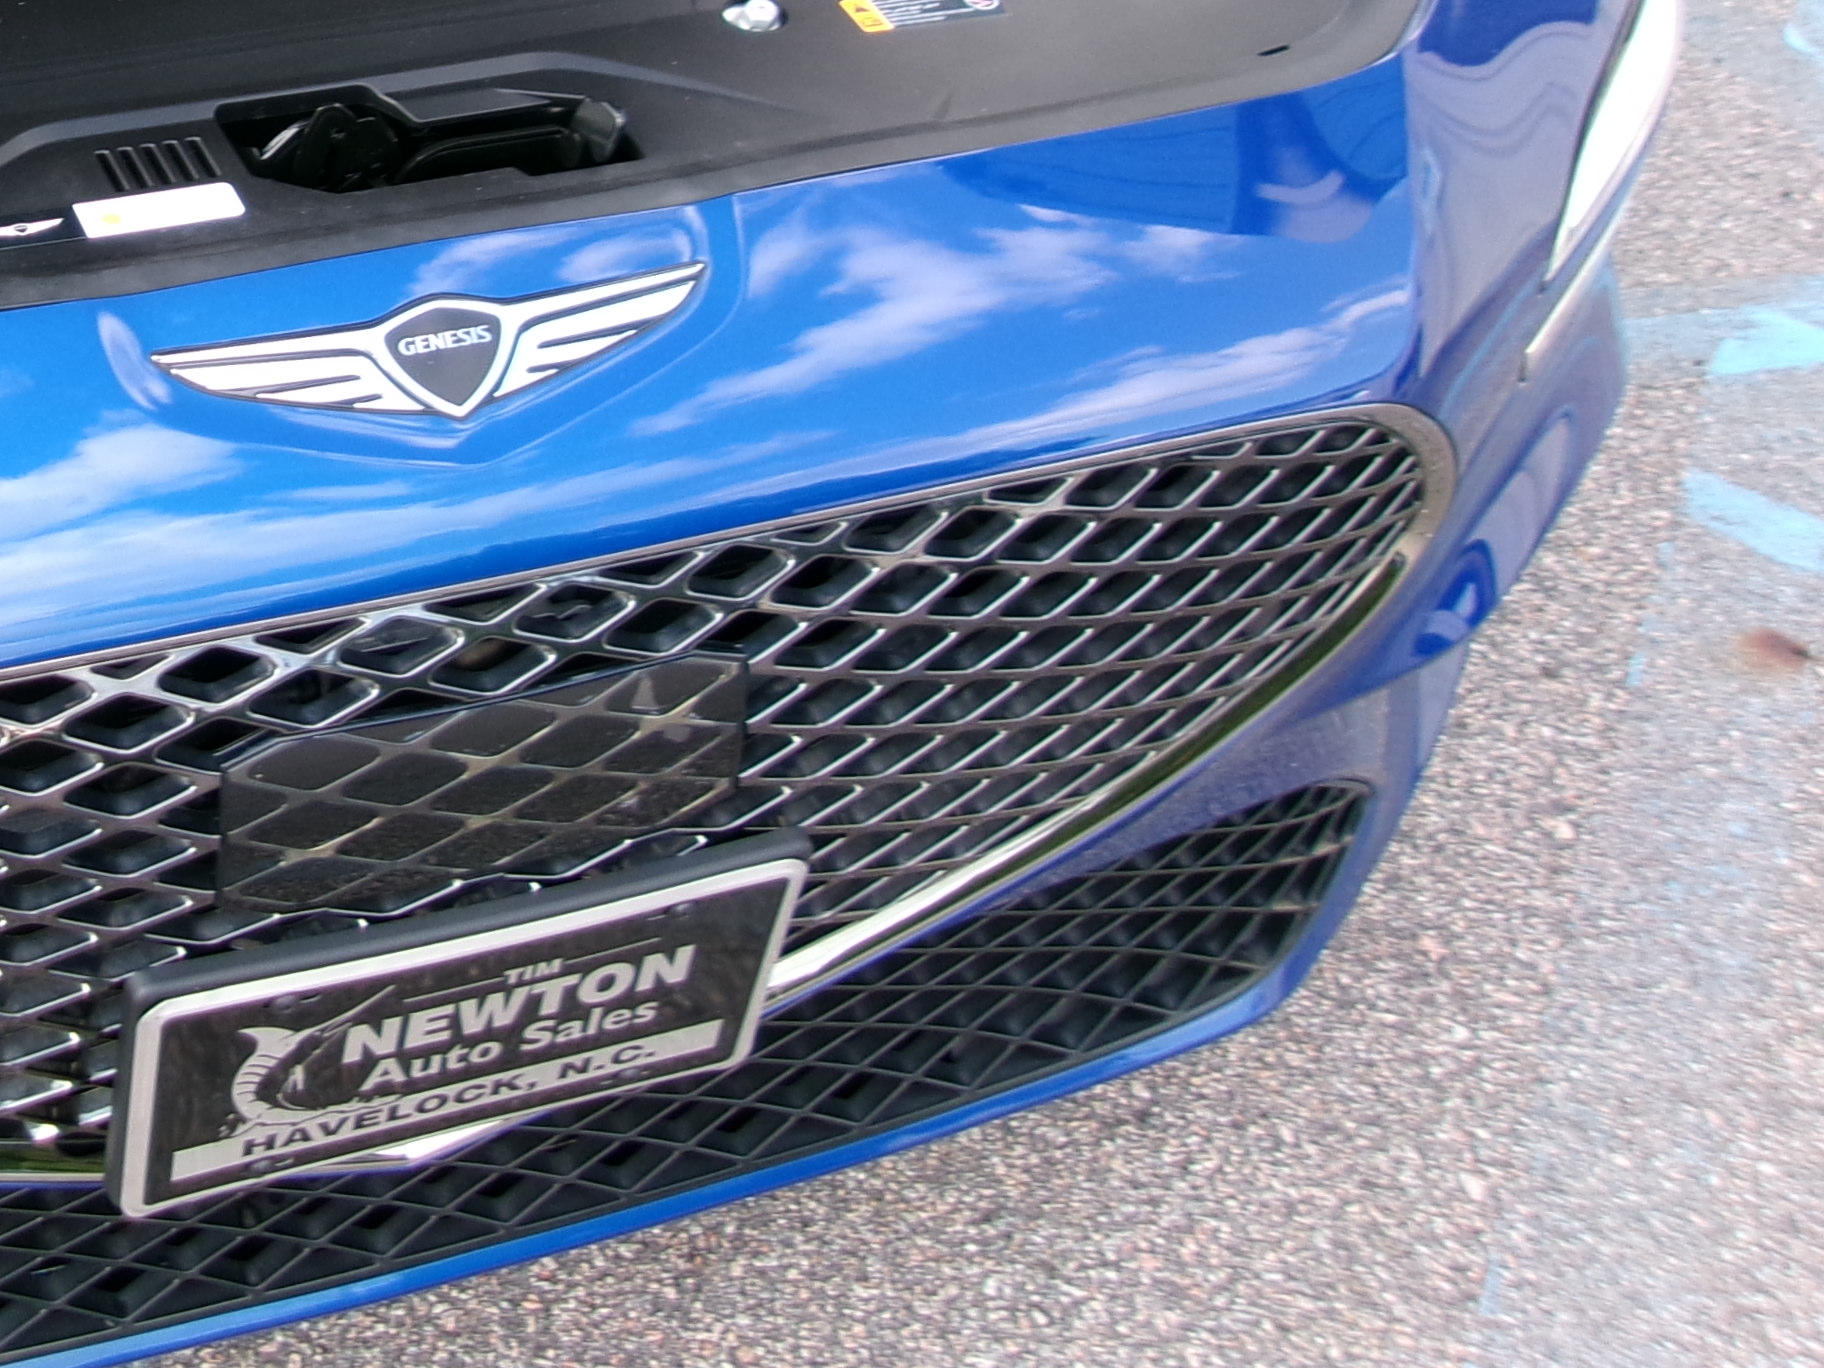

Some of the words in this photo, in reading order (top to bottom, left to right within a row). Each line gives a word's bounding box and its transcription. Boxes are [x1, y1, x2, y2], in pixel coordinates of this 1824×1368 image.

[397, 324, 493, 356] GENESIS
[341, 943, 696, 1064] NEWTON
[503, 958, 565, 984] TIM
[358, 1041, 503, 1092] Auto
[519, 1001, 660, 1051] Sales
[241, 1073, 538, 1157] HAVELOCK,
[557, 1044, 657, 1080] N.C.
